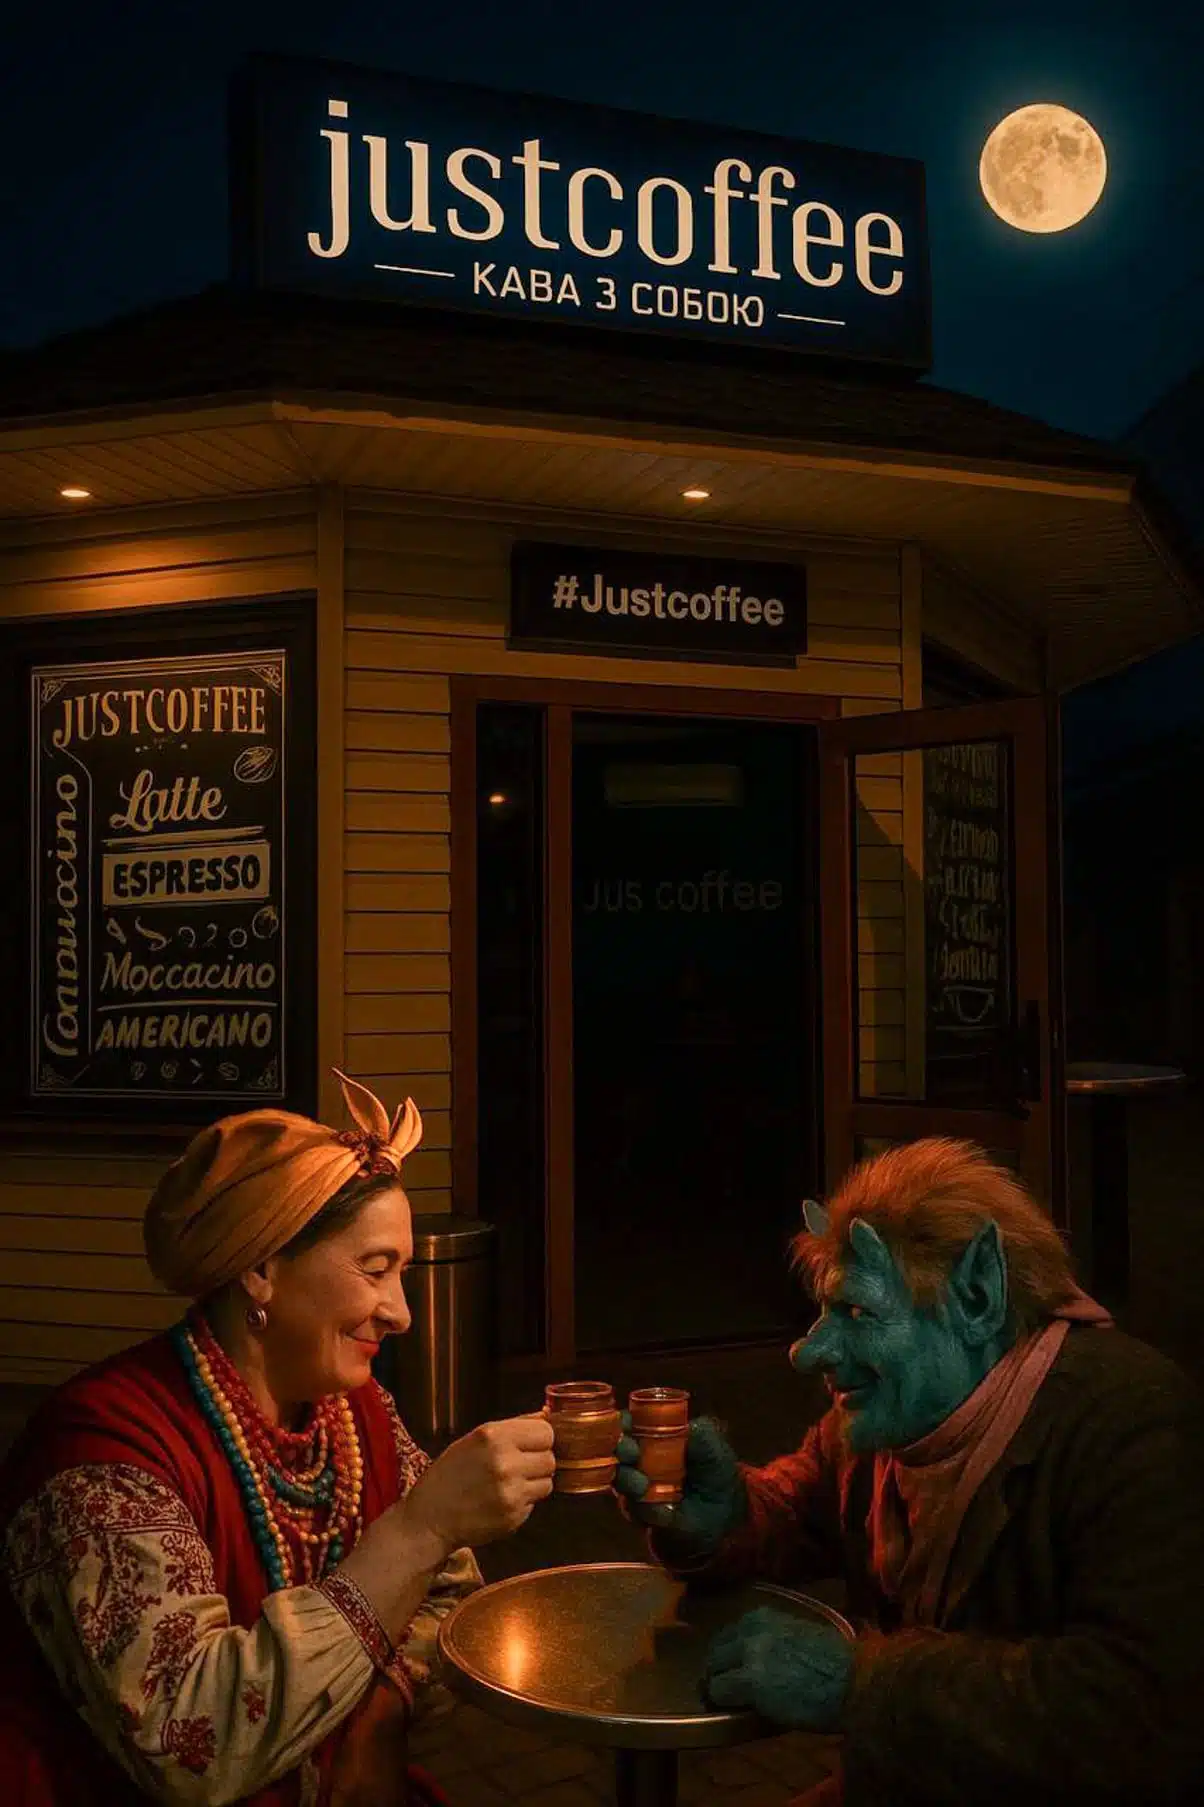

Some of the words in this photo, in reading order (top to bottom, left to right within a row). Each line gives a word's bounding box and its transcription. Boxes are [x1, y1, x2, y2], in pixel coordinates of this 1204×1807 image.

[308, 99, 906, 296] justcoffee
[472, 261, 581, 307] КАВА
[596, 278, 617, 310] З
[631, 282, 765, 328] СОБОЮ
[553, 574, 785, 626] #Justcoffee
[52, 686, 267, 749] JUSTCOFFEE
[108, 768, 228, 833] Latte
[112, 854, 261, 898] ESPRESSO
[655, 869, 784, 913] coffee
[100, 952, 276, 994] Moccacino
[97, 1011, 272, 1050] AMERICANO
